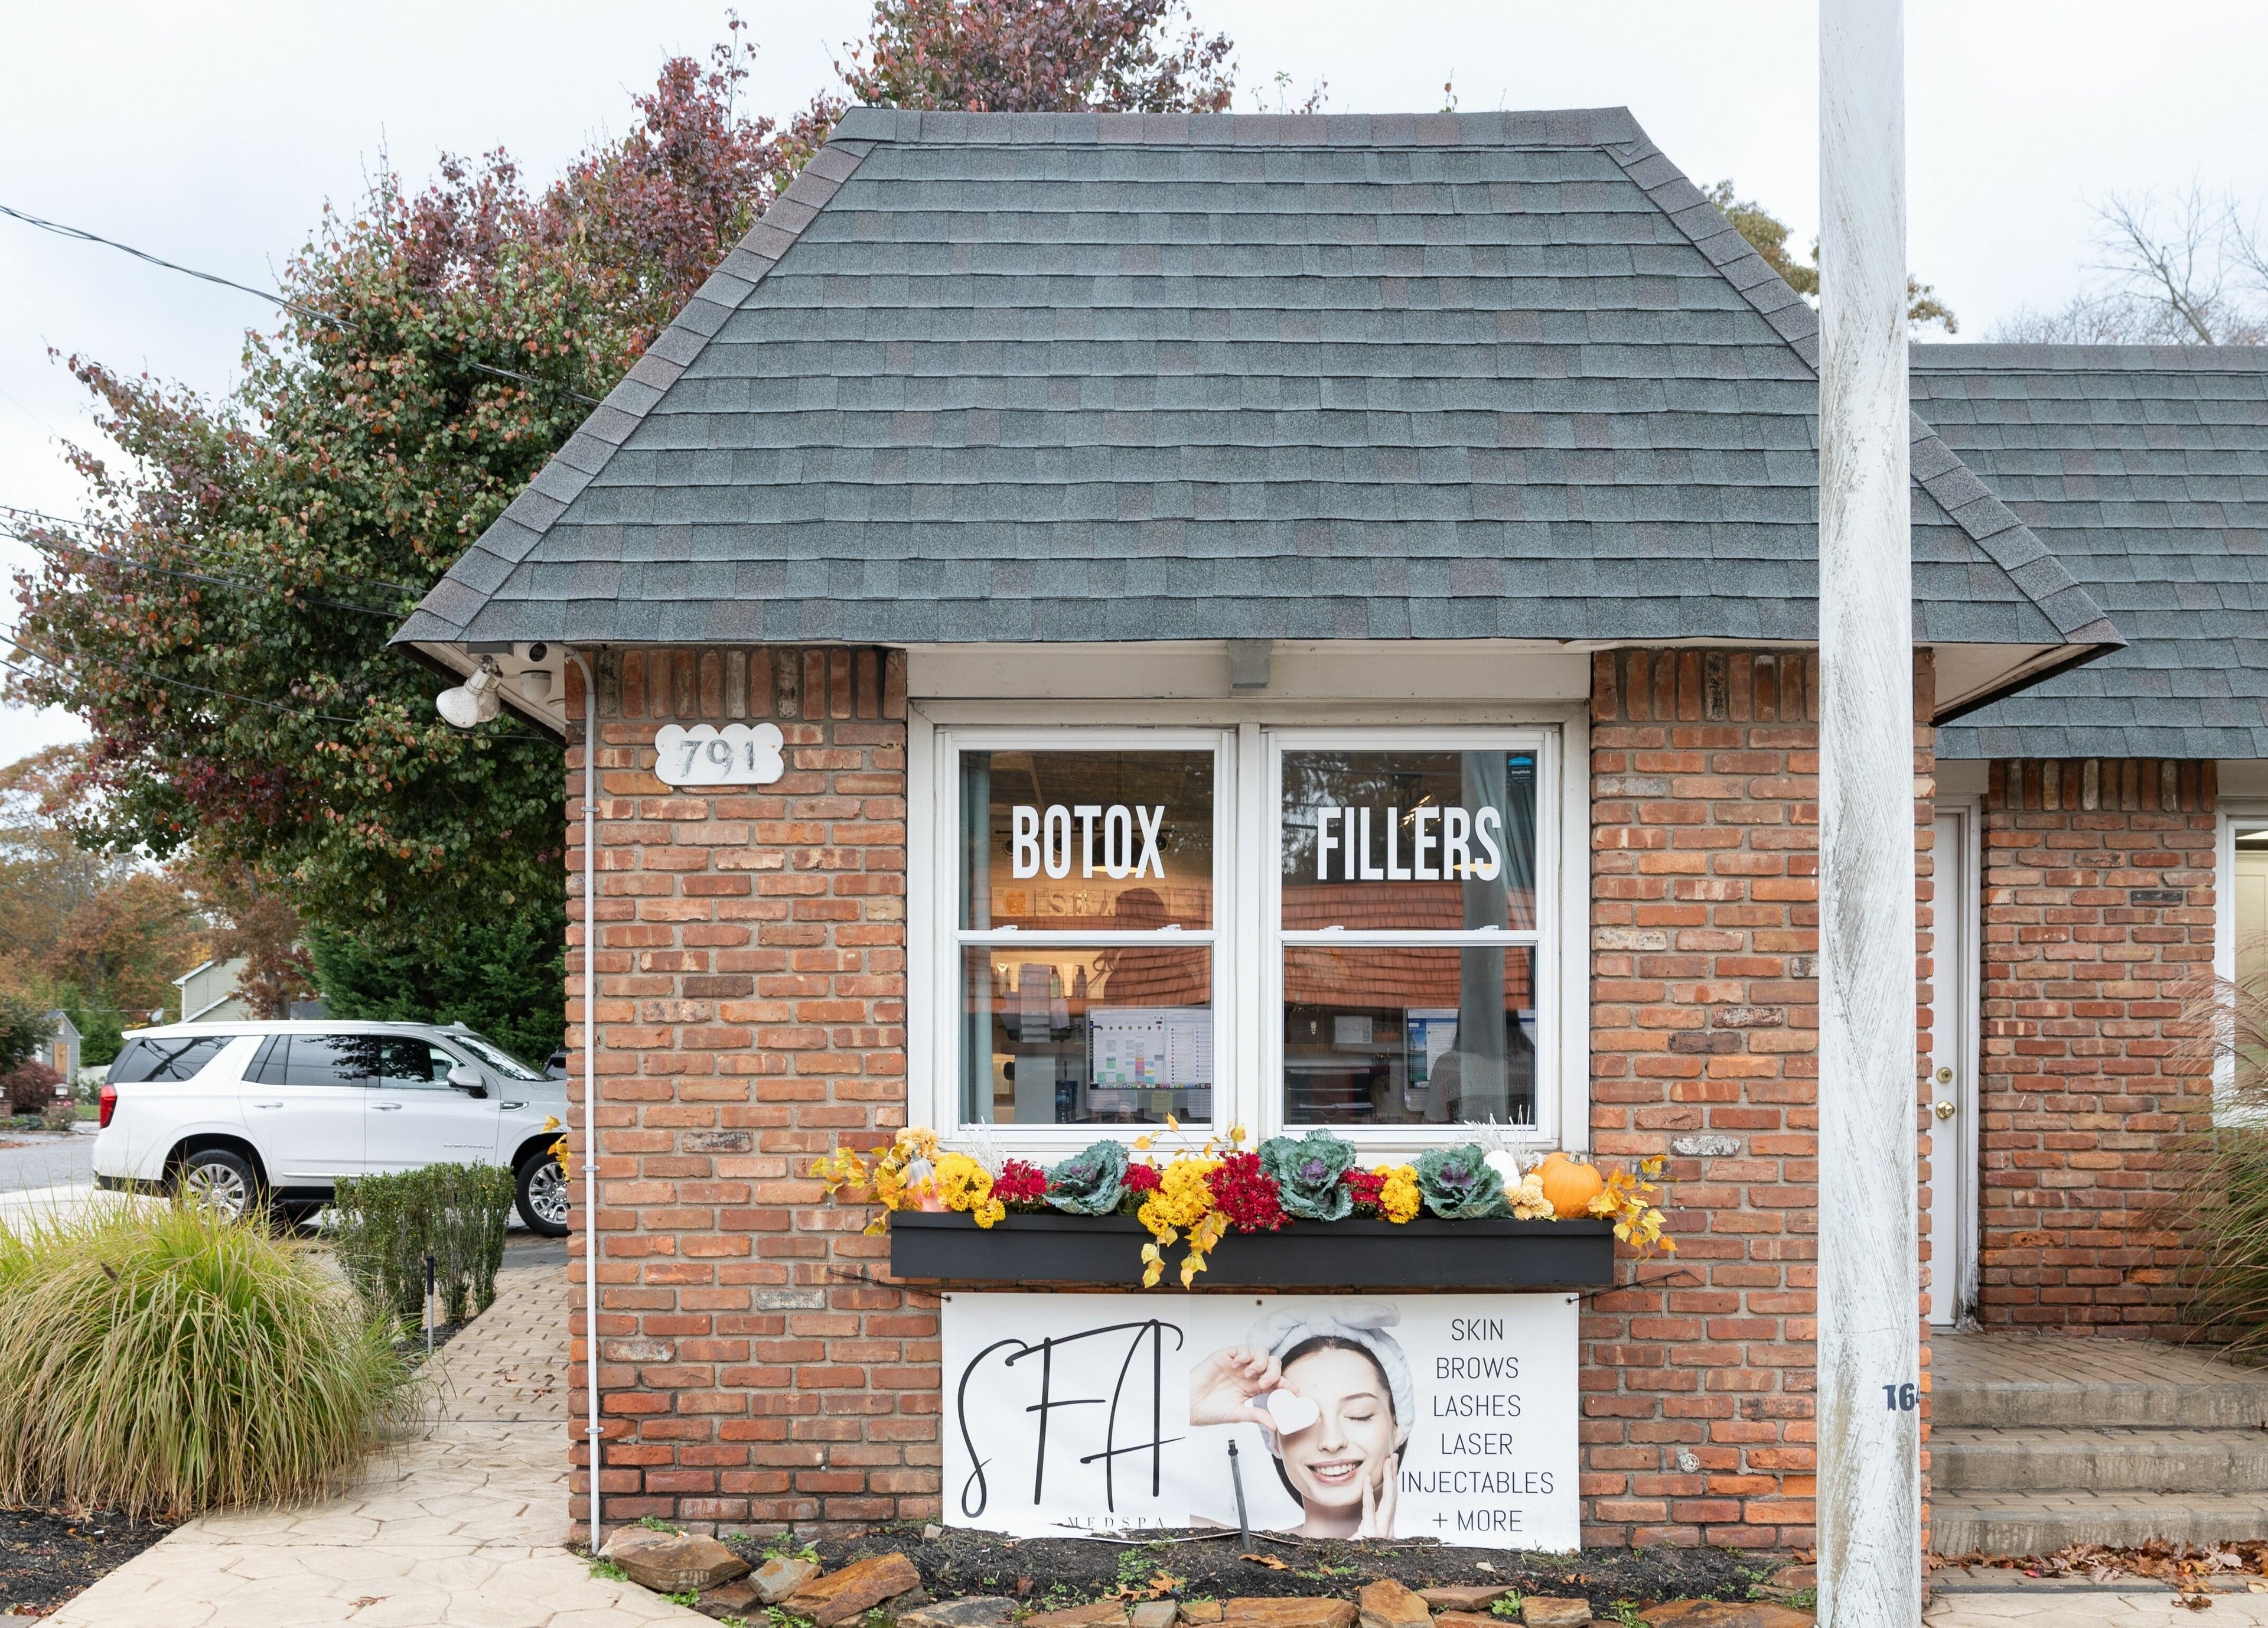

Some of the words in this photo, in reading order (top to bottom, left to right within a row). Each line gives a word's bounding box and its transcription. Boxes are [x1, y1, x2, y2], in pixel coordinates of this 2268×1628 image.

[680, 739, 755, 779] 791
[1012, 805, 1166, 880] BOTOX
[1317, 806, 1501, 881] FILLERS
[1451, 1318, 1503, 1341] SKIN
[1436, 1357, 1518, 1379] BROWS
[1433, 1395, 1521, 1417] LASHES
[1882, 1383, 1920, 1411] 16
[958, 1318, 1186, 1518] SFA
[1442, 1433, 1513, 1455] LASER
[1402, 1471, 1554, 1494] INJECTABLES
[1432, 1512, 1448, 1528] +
[1458, 1509, 1523, 1532] MORE
